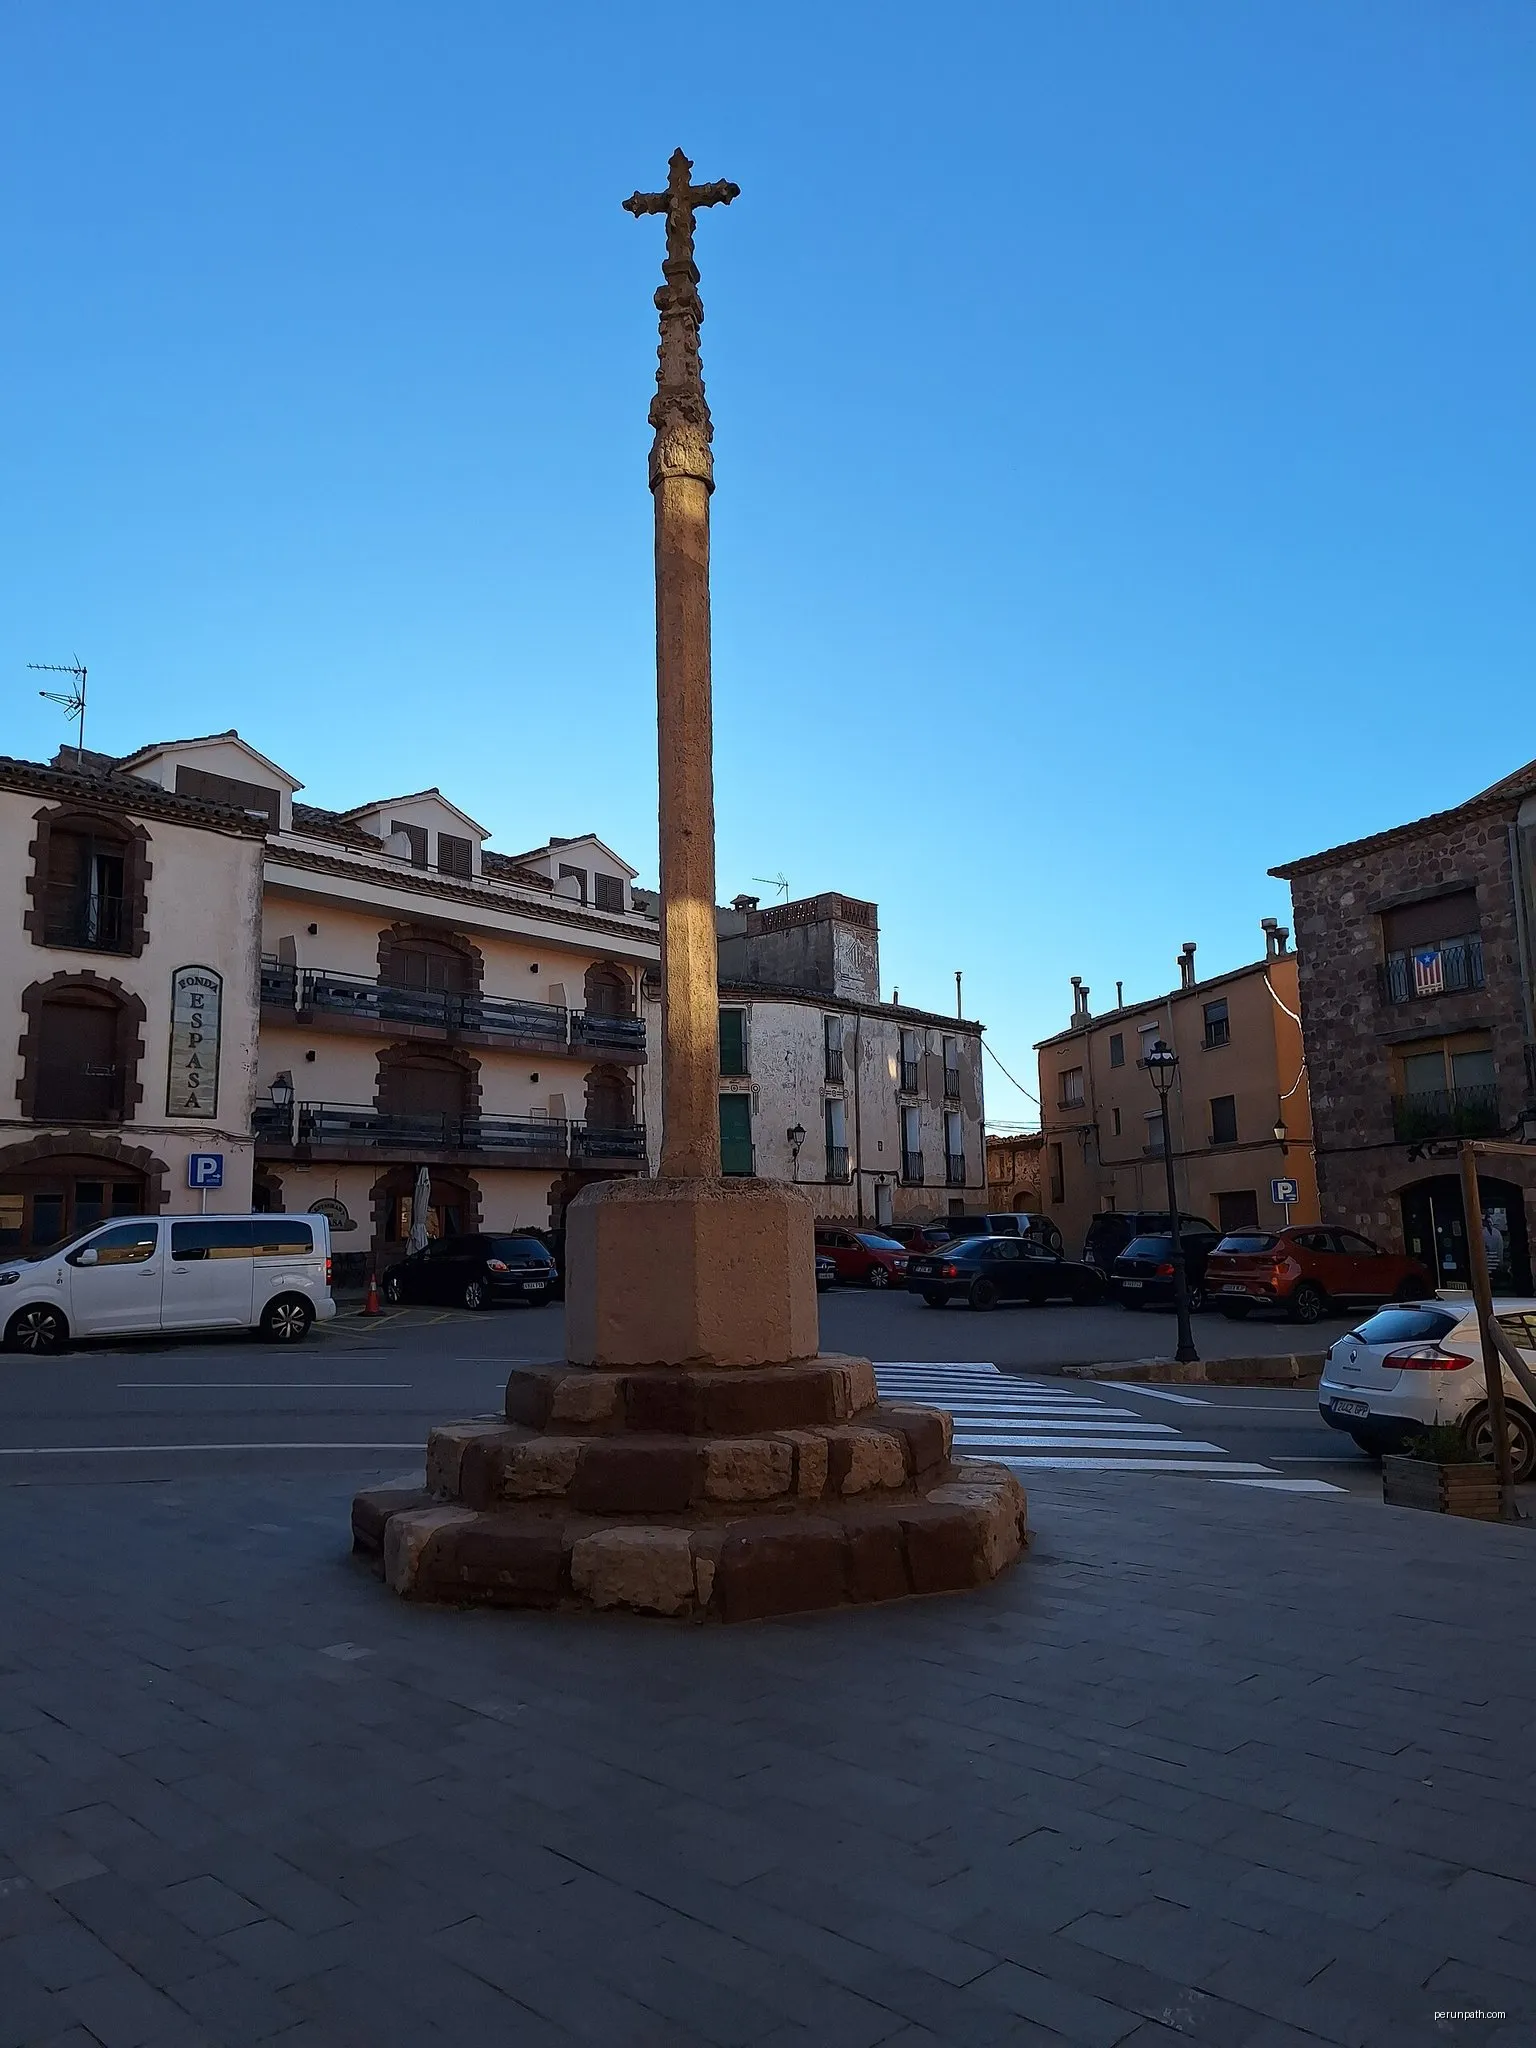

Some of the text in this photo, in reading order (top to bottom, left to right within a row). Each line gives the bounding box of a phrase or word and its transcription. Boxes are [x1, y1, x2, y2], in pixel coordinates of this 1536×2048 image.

[178, 976, 219, 993] FONDA
[184, 992, 205, 1108] ESPASA
[197, 1157, 217, 1183] P
[1277, 1182, 1293, 1200] P
